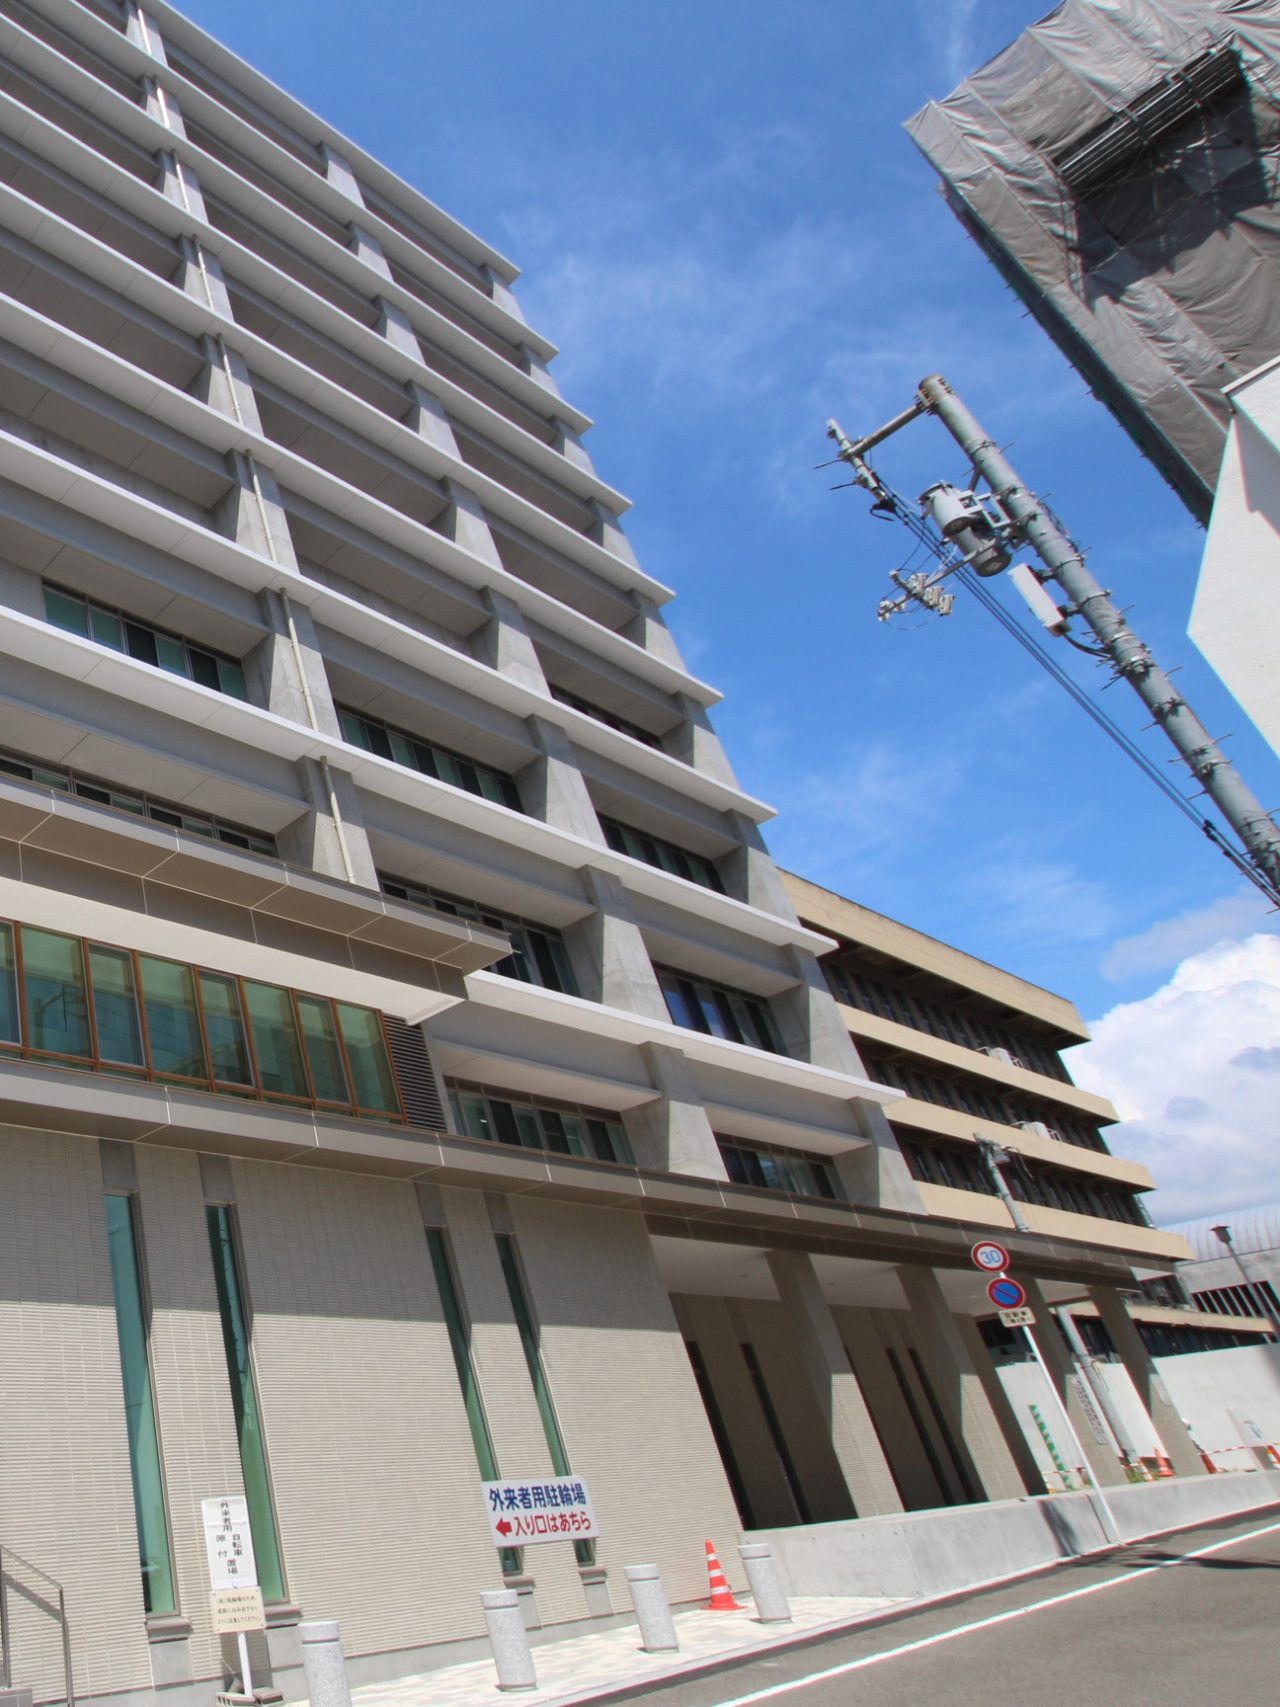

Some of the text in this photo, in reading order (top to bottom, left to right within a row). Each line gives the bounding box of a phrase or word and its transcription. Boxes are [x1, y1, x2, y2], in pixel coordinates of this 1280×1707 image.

[980, 1249, 1002, 1265] 30
[489, 1483, 587, 1512] 外来者用駐輪場
[514, 1511, 592, 1537] 入り口はあちら
